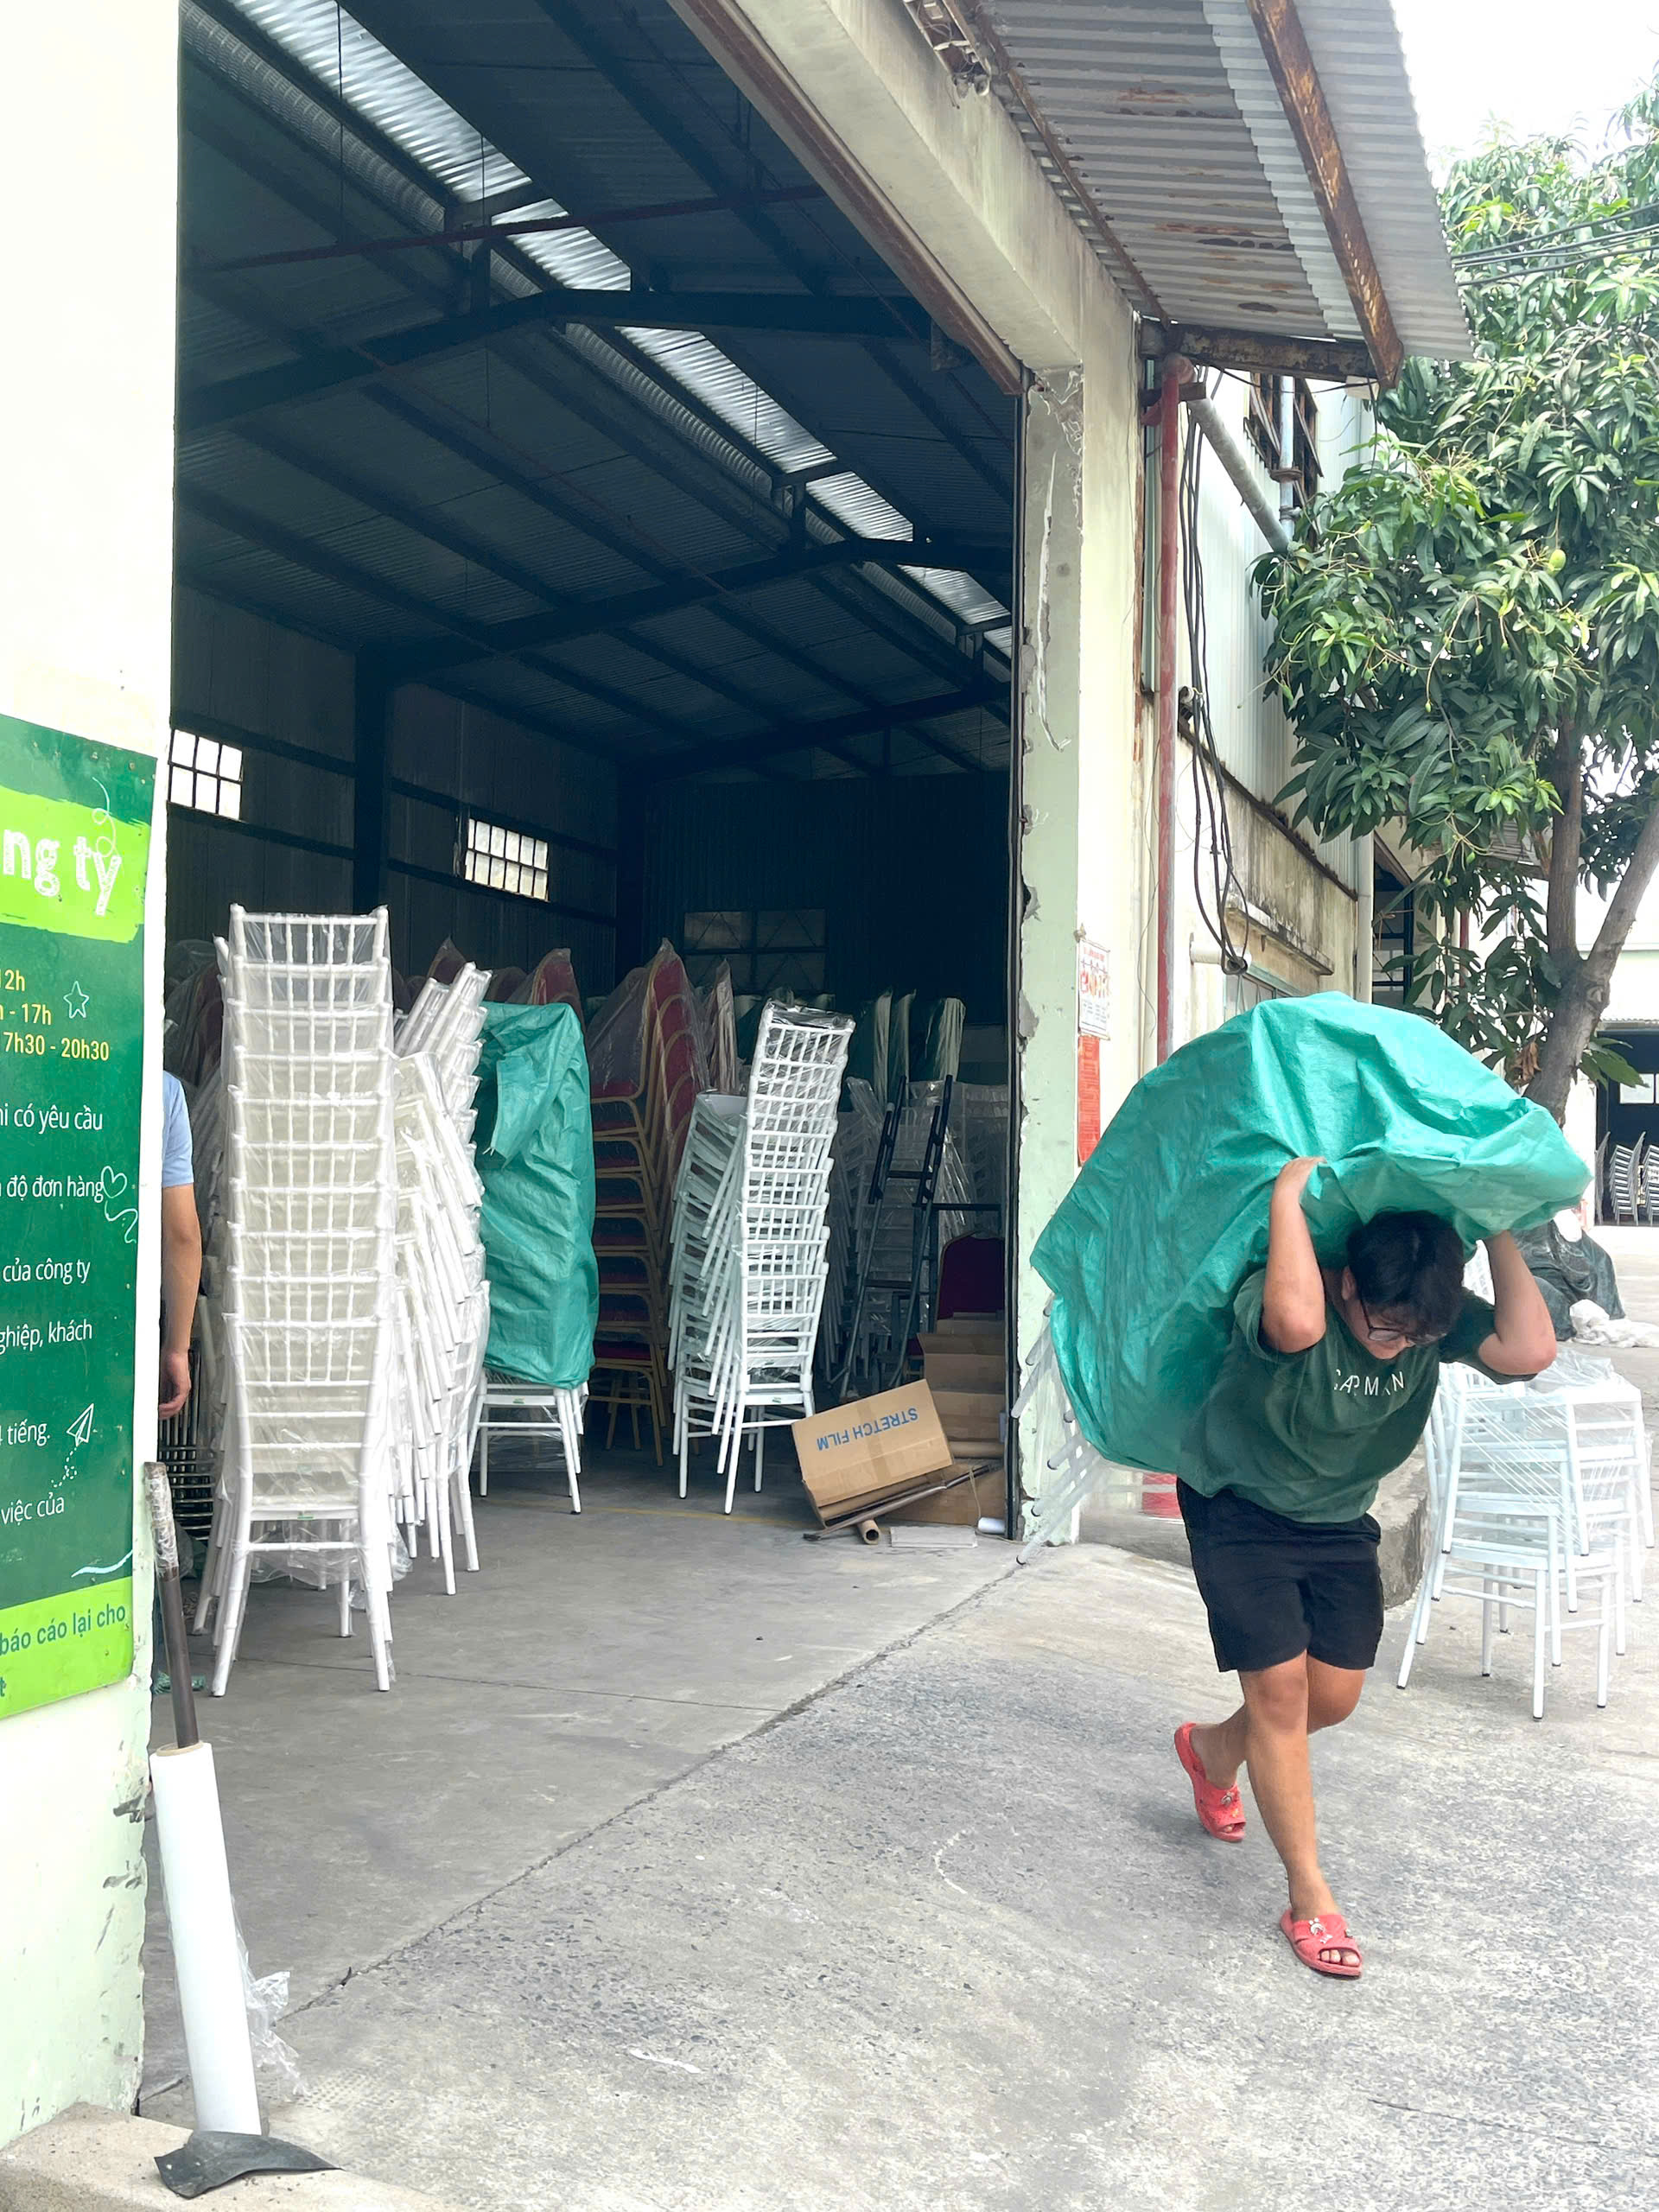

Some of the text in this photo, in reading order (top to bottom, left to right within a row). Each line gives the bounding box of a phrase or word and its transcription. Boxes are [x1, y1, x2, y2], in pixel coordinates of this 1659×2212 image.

[73, 835, 122, 917] ty
[22, 1002, 52, 1026] 17h
[3, 1032, 45, 1056] 7h30
[60, 1037, 110, 1061] 20h30
[14, 1103, 35, 1128] có
[38, 1104, 70, 1135] yêu
[74, 1104, 103, 1131] cầu
[7, 1174, 105, 1204] độ đơn hàng
[3, 1257, 91, 1285] của công ty
[48, 1318, 92, 1344] khách
[7, 1418, 51, 1446] tiếng.
[816, 1407, 919, 1452] STRETCH FILM
[1, 1491, 65, 1526] việc của
[0, 1603, 126, 1656] báo cáo lại cho
